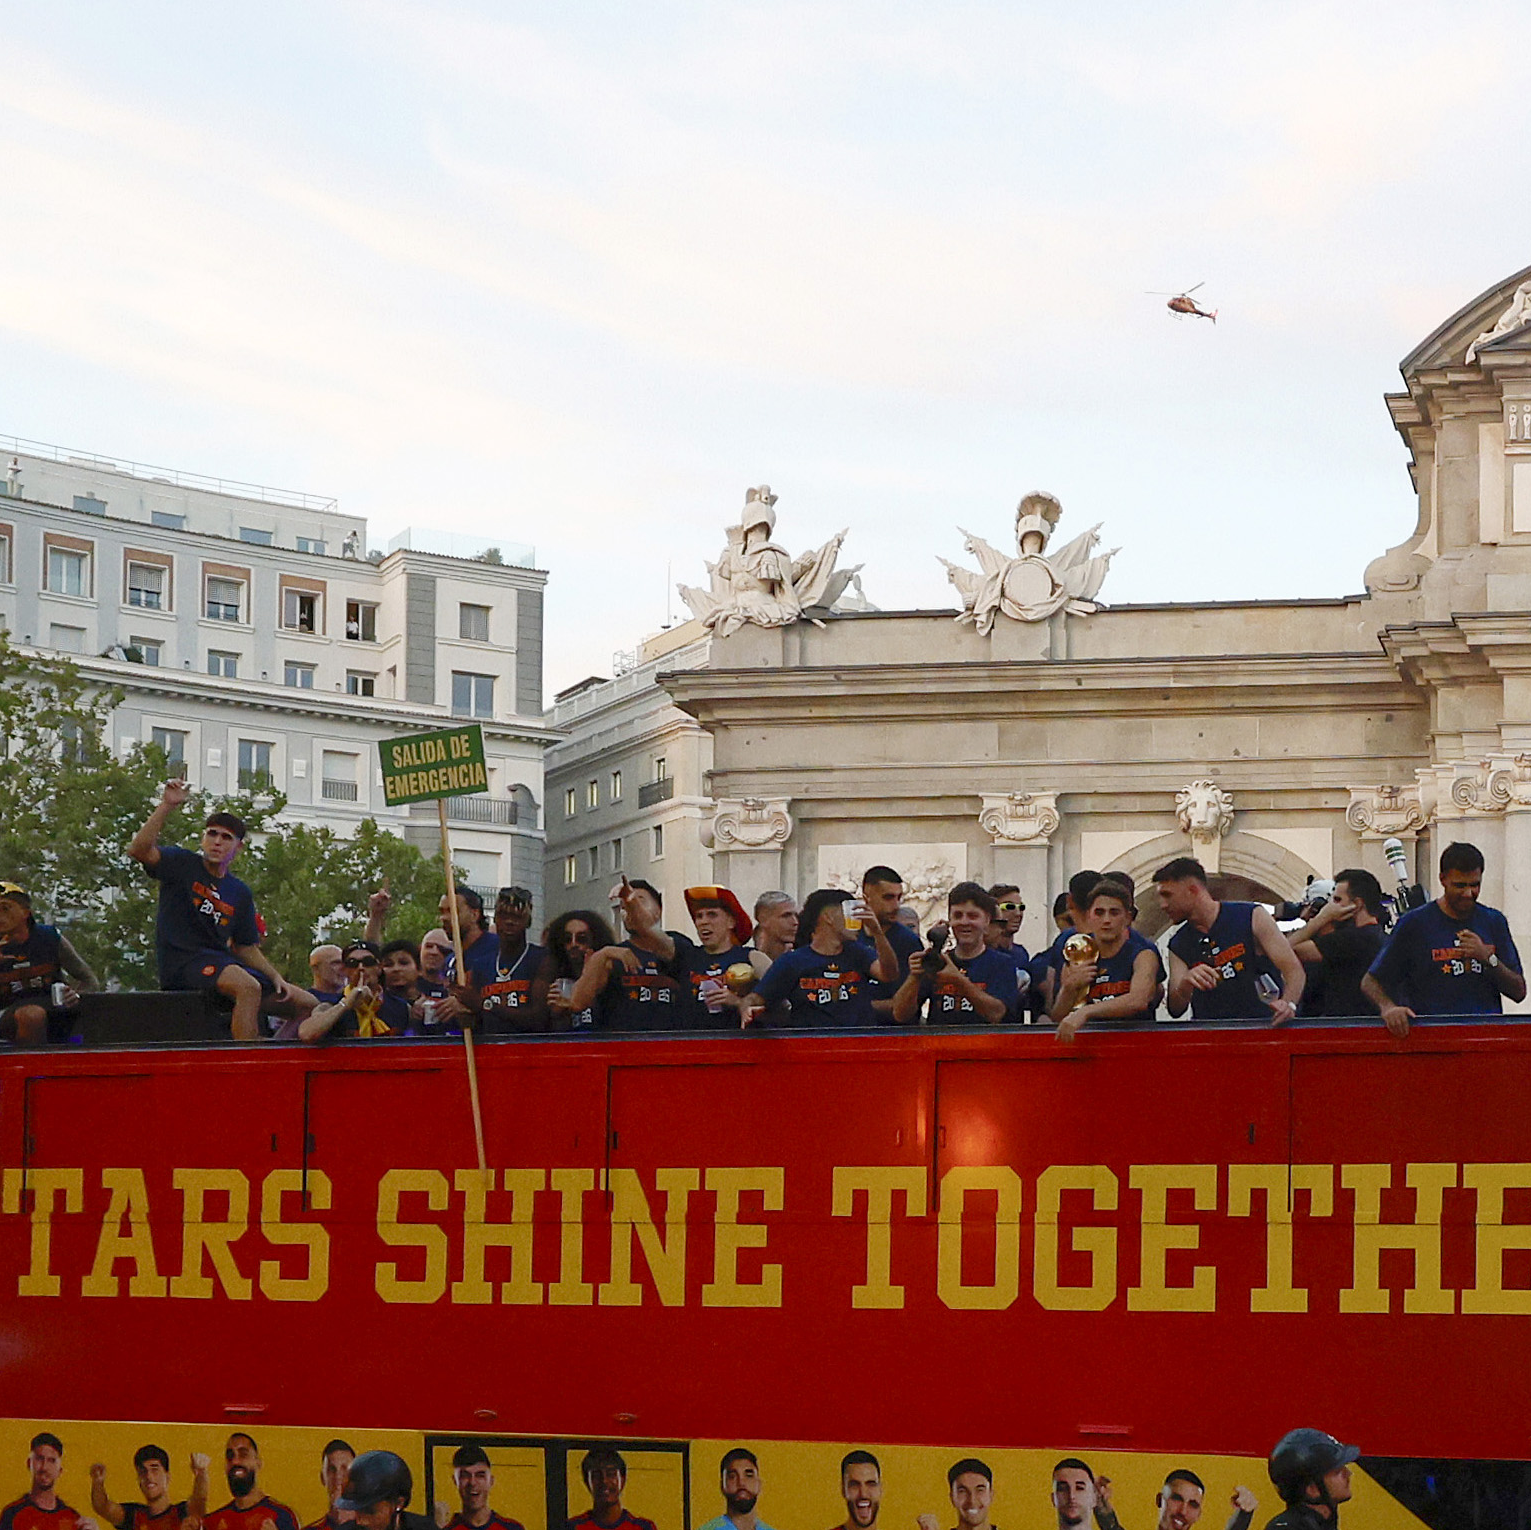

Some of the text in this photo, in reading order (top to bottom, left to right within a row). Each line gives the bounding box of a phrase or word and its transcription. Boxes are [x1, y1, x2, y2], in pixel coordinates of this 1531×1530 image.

[391, 734, 473, 770] SALIDA DE
[385, 762, 487, 801] EMERGENCIA
[376, 1167, 785, 1308] SHINE
